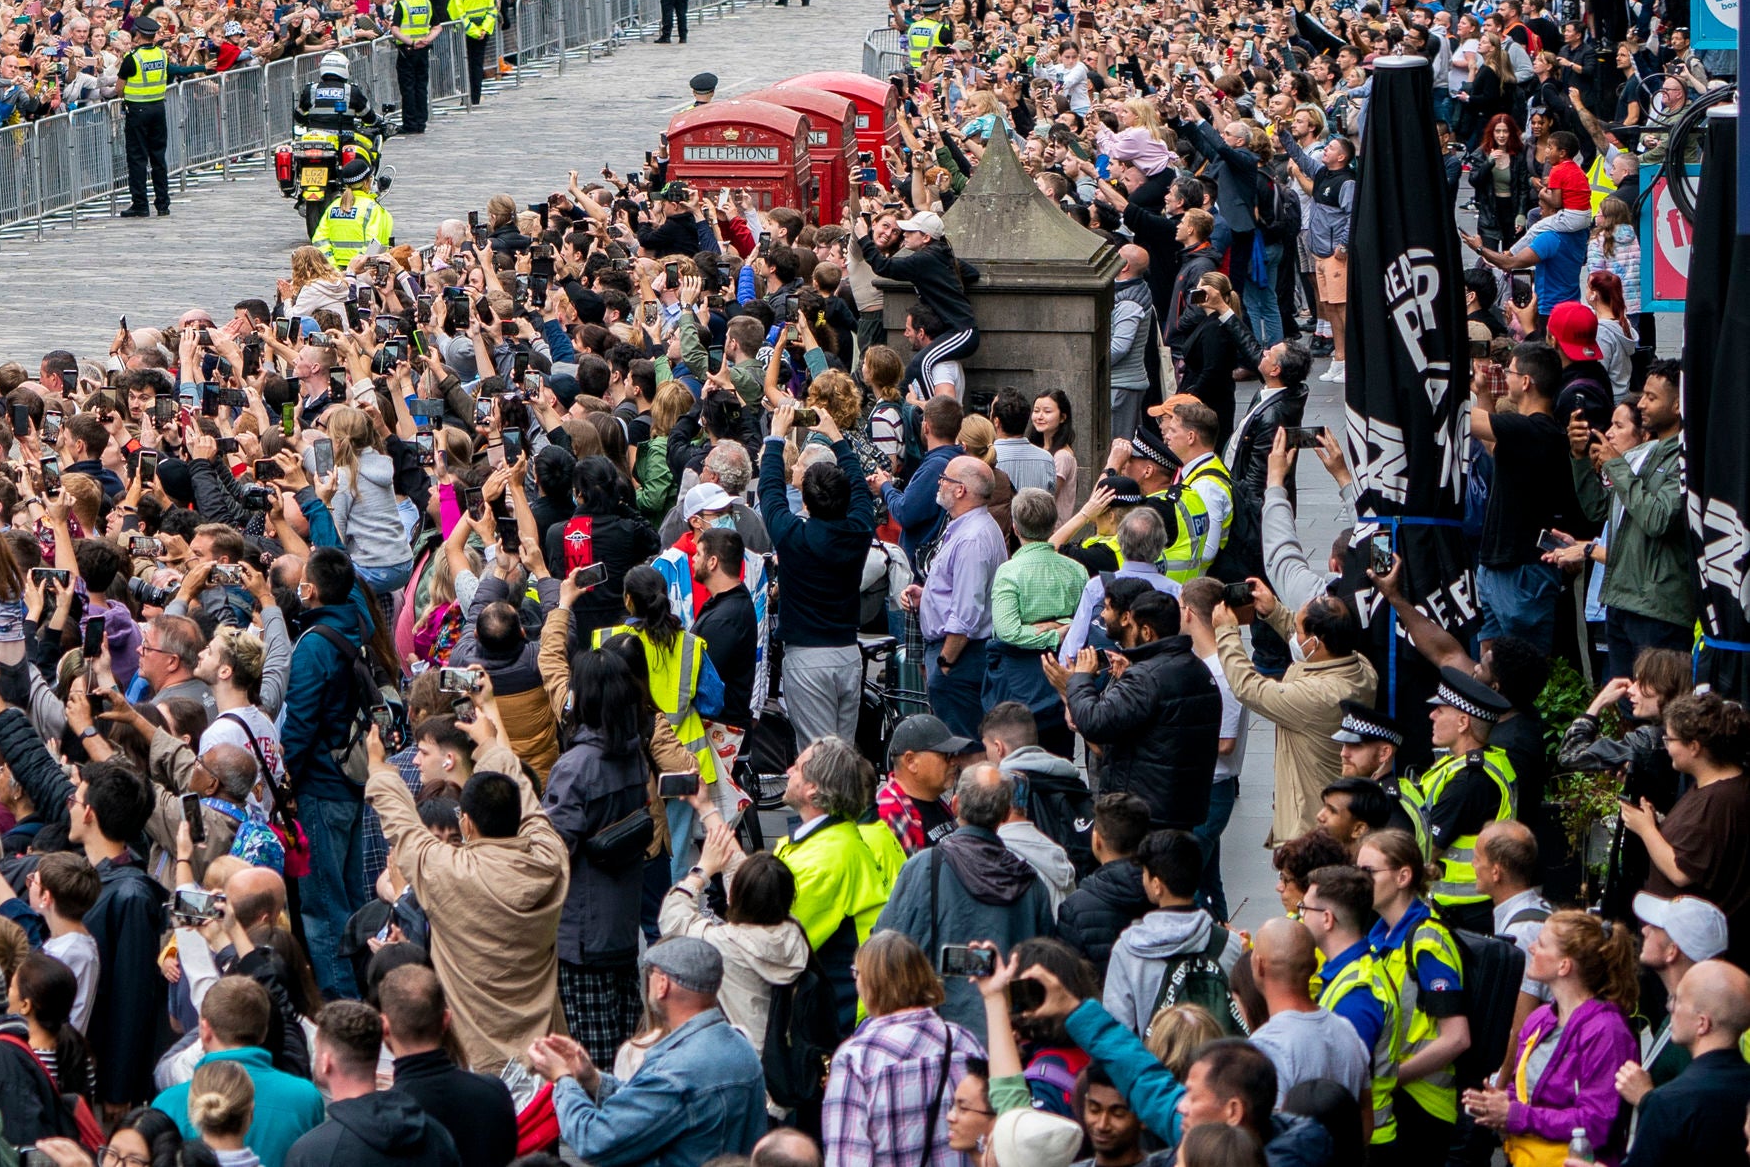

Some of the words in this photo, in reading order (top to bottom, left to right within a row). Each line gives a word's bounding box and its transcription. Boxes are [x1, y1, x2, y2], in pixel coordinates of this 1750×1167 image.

[1721, 2, 1738, 10] box
[912, 28, 932, 36] POLICE
[143, 60, 165, 72] POLICE
[316, 88, 344, 99] POLICE
[687, 147, 775, 161] TELEPHONE
[305, 177, 323, 185] VNZ
[927, 822, 947, 842] BUILT
